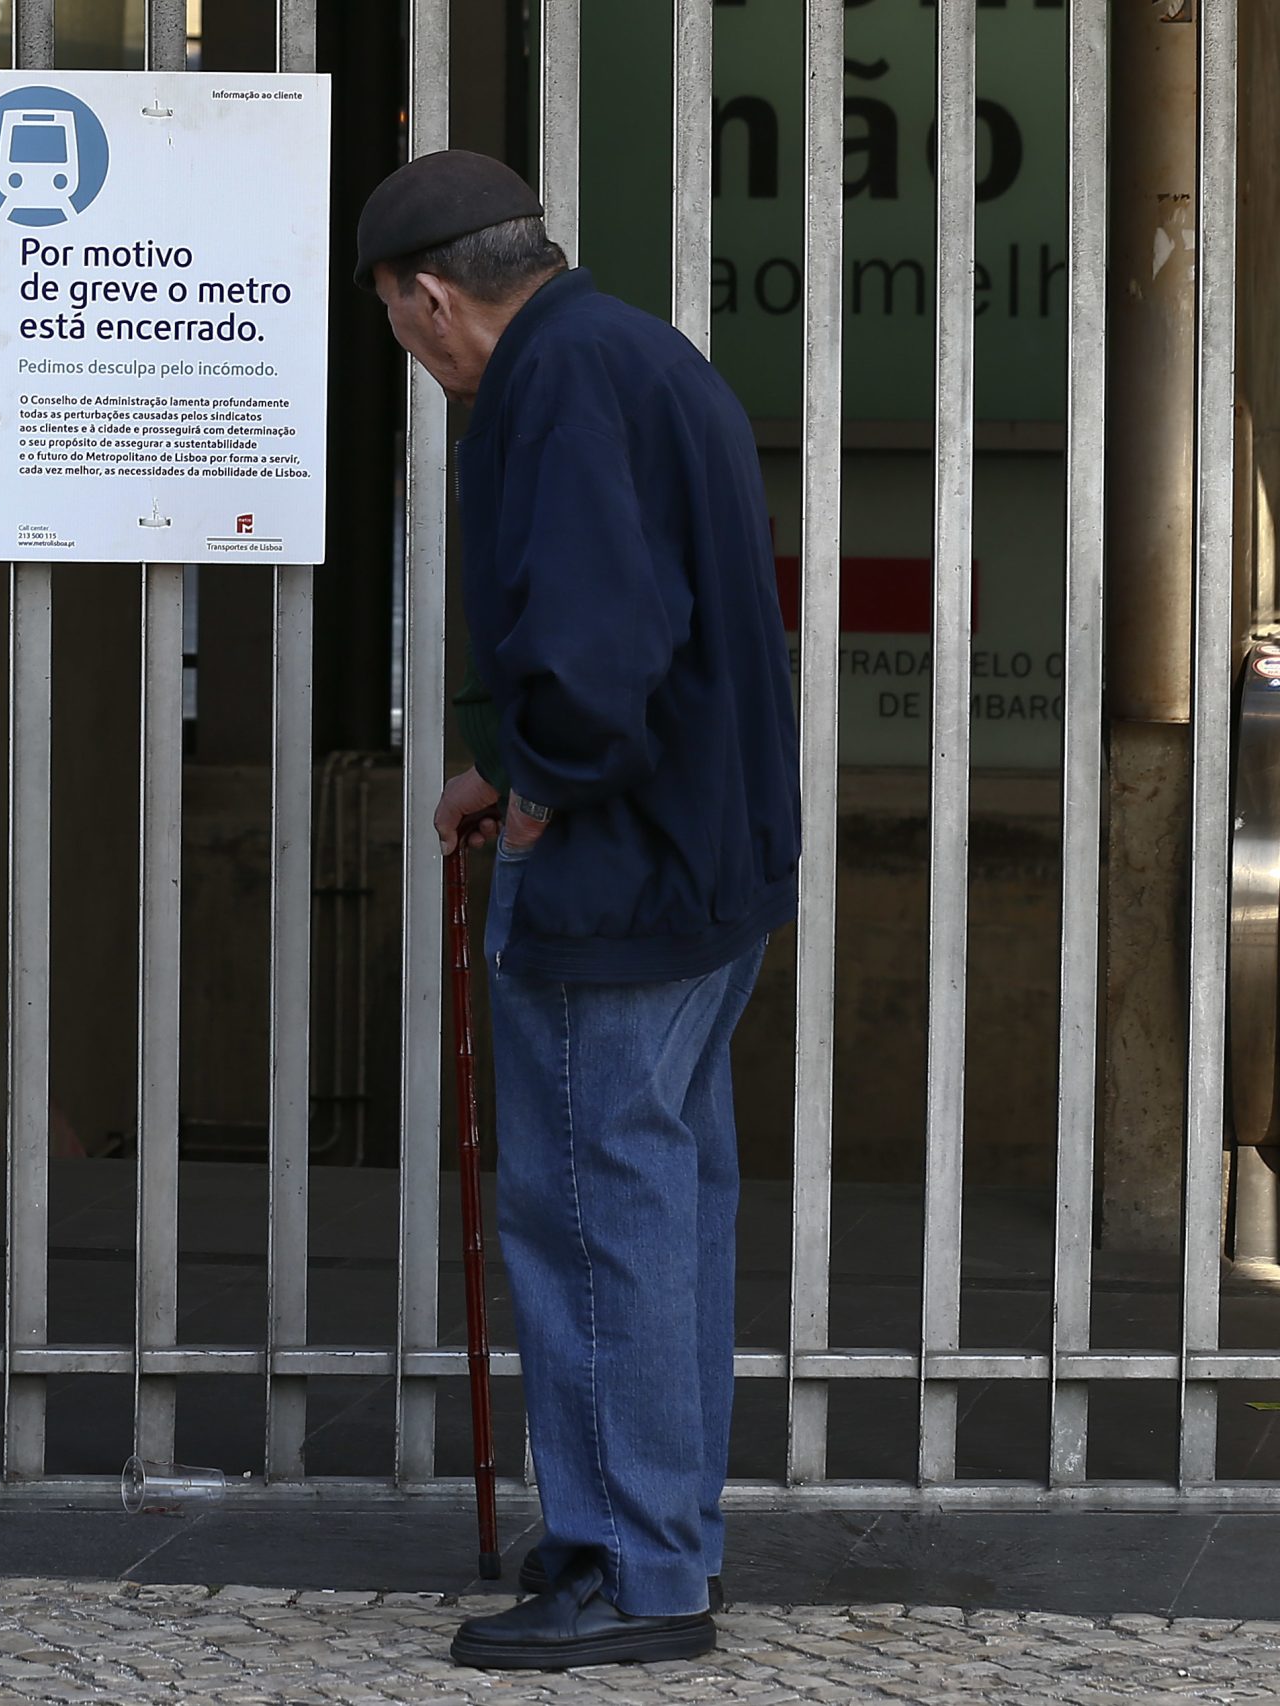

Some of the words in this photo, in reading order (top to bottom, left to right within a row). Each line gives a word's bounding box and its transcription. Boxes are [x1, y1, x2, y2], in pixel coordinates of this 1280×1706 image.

[213, 90, 259, 100] Informação
[274, 91, 302, 99] cliente
[709, 58, 1023, 203] não
[22, 238, 73, 266] Por
[84, 240, 192, 267] motivo
[21, 272, 58, 300] de
[70, 281, 157, 309] greve
[169, 283, 187, 302] o
[199, 278, 290, 303] metro
[20, 311, 86, 339] está
[97, 312, 264, 341] encerrado.
[19, 359, 83, 373] Pedimos
[88, 360, 155, 378] desculpa
[161, 361, 193, 378] pelo
[199, 362, 277, 376] incómodo.
[20, 395, 28, 404] O
[31, 396, 77, 404] Conselho
[80, 396, 92, 405] de
[95, 396, 167, 408] Administração
[170, 397, 209, 406] lamenta
[213, 397, 289, 409] profundamente
[20, 409, 48, 418] todas
[64, 410, 130, 421] perturbações
[133, 411, 178, 420] causadas
[181, 411, 208, 422] pelos
[211, 412, 262, 421] sindicatos
[40, 423, 79, 432] clientes
[90, 424, 95, 433] à
[98, 424, 131, 433] cidade
[143, 425, 200, 436] prosseguirá
[227, 425, 295, 437] determinação
[49, 438, 97, 449] propósito
[100, 438, 112, 447] de
[115, 441, 163, 450] assegurar
[174, 439, 257, 449] sustentabilidade
[37, 451, 68, 460] futuro
[71, 451, 83, 460] do
[86, 452, 157, 463] Metropolitano
[160, 453, 173, 462] de
[175, 453, 207, 462] Lisboa
[210, 456, 227, 464] por
[229, 453, 258, 464] forma
[270, 455, 299, 464] servir,
[20, 465, 42, 474] cada
[65, 465, 102, 476] melhor,
[118, 466, 185, 476] necessidades
[188, 467, 199, 476] da
[202, 467, 257, 476] mobilidade
[260, 468, 272, 477] de
[276, 468, 310, 477] Lisboa.
[207, 543, 247, 552] Transportes
[789, 649, 931, 677] ETRADA
[969, 652, 1032, 678] ELO
[879, 691, 920, 718] DE
